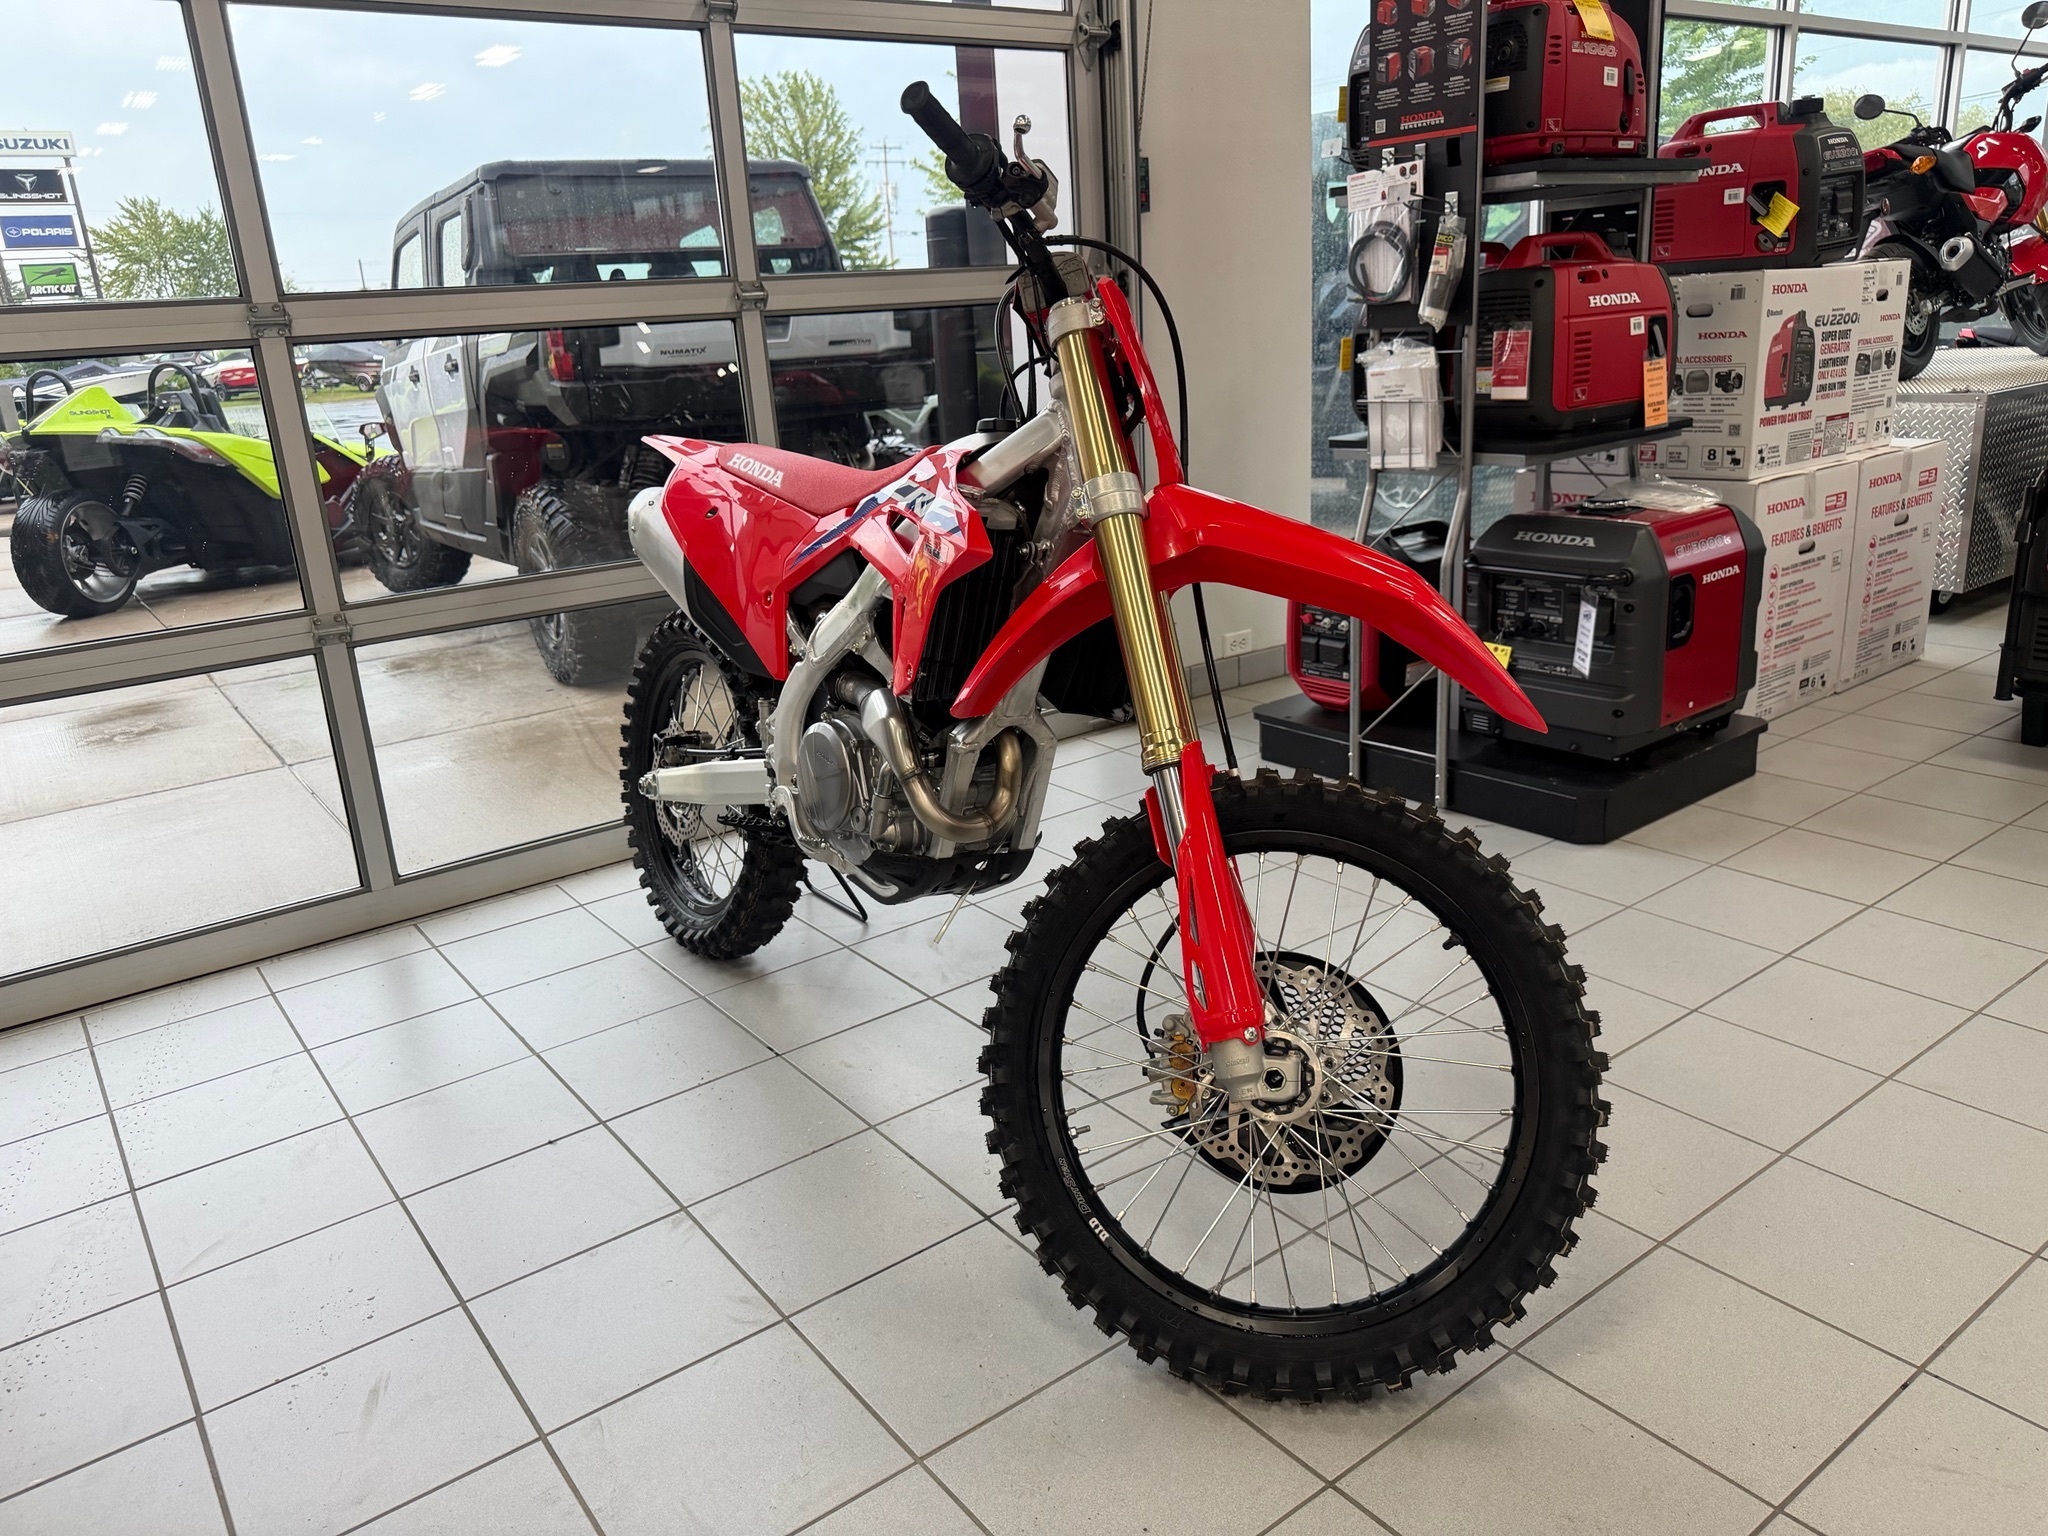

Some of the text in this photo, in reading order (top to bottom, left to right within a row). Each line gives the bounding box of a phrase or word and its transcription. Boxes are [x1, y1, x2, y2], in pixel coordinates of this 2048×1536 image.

[1400, 110, 1444, 124] HONDA
[1400, 120, 1444, 130] GENERATORS
[1827, 136, 1849, 145] HONDA
[1698, 162, 1744, 178] NDA
[22, 227, 74, 236] POLARIS
[30, 284, 77, 295] ARCTIC CAT
[1772, 283, 1808, 295] HONDA
[1588, 292, 1641, 307] HONDA
[1814, 312, 1860, 327] EU2200i
[1880, 313, 1901, 322] HONDA
[1697, 331, 1748, 340] HONDA
[1821, 329, 1852, 342] SUPER QUIET
[659, 346, 707, 356] NUMATIX
[1820, 341, 1851, 355] GENERATOR
[1685, 355, 1733, 364] ACCESSORIES
[1818, 356, 1849, 369] LIGHTWEIGHT
[1818, 369, 1830, 380] ONLY
[1816, 382, 1827, 393] LONG
[1828, 382, 1836, 392] RUN
[1836, 381, 1847, 391] TIME
[1759, 410, 1812, 427] POWER YOU CAN TRUST
[1707, 448, 1717, 461] 8
[727, 453, 784, 488] HONDA
[1869, 472, 1902, 488] HONDA
[1767, 497, 1805, 515] HONDA
[1871, 491, 1933, 519] FEATURES & BENEFITS
[1771, 517, 1842, 547] FEATURES & BENEFITS
[1513, 531, 1596, 548] HONDA
[1674, 534, 1732, 558] EU3000is
[1702, 564, 1740, 584] HONDA
[1810, 677, 1816, 688] 6
